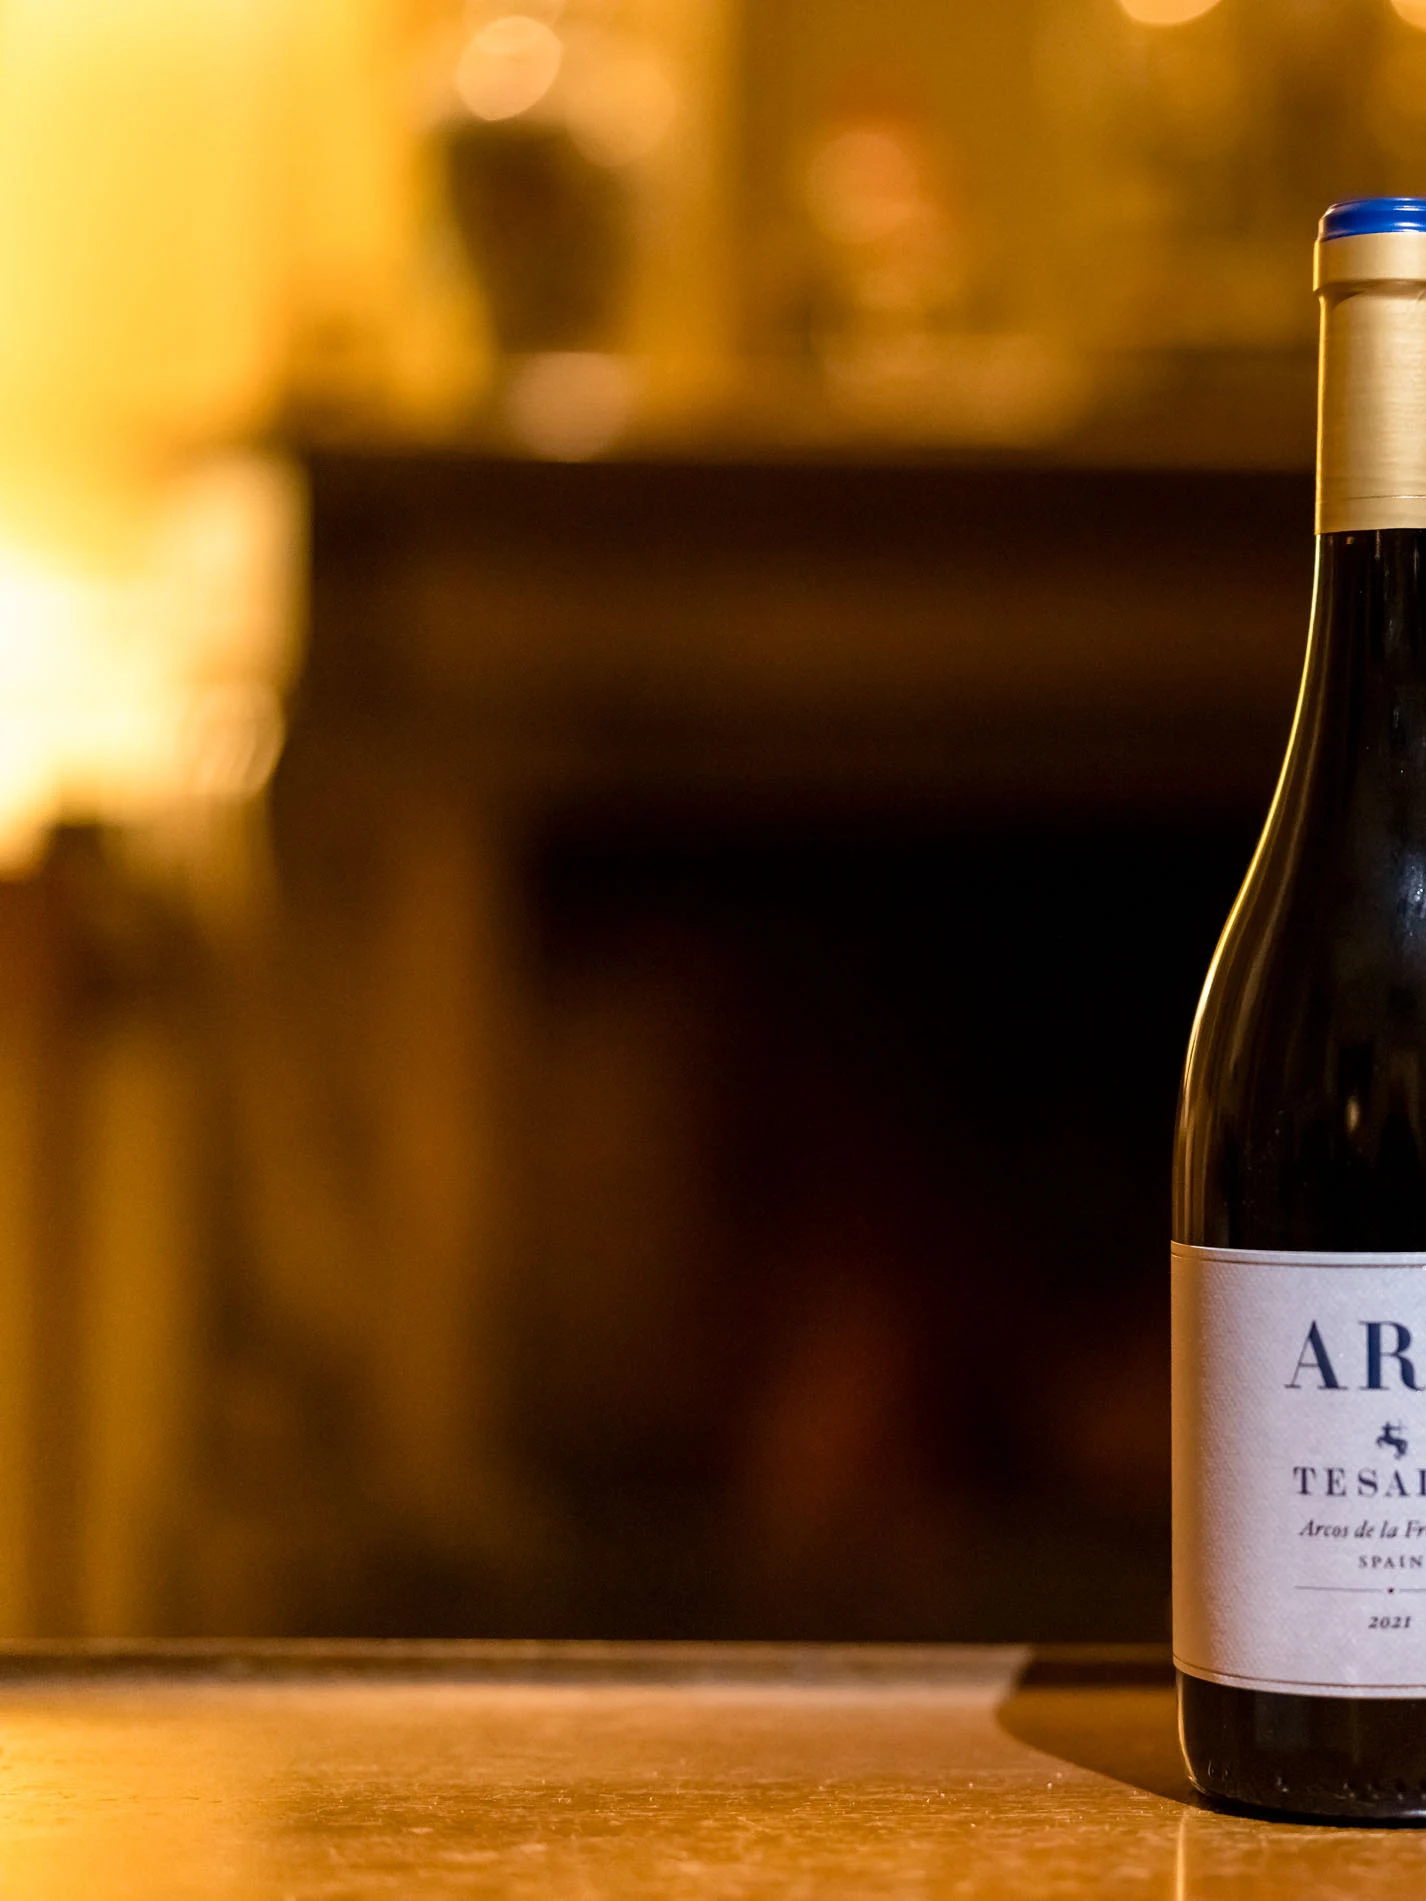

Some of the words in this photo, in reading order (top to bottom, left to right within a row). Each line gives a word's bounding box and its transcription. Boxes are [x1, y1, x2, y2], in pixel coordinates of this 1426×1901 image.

[1299, 1519, 1349, 1539] Arcos
[1354, 1519, 1375, 1539] de
[1379, 1520, 1399, 1539] la
[1358, 1555, 1424, 1569] SPAIN
[1367, 1615, 1412, 1630] 2021
